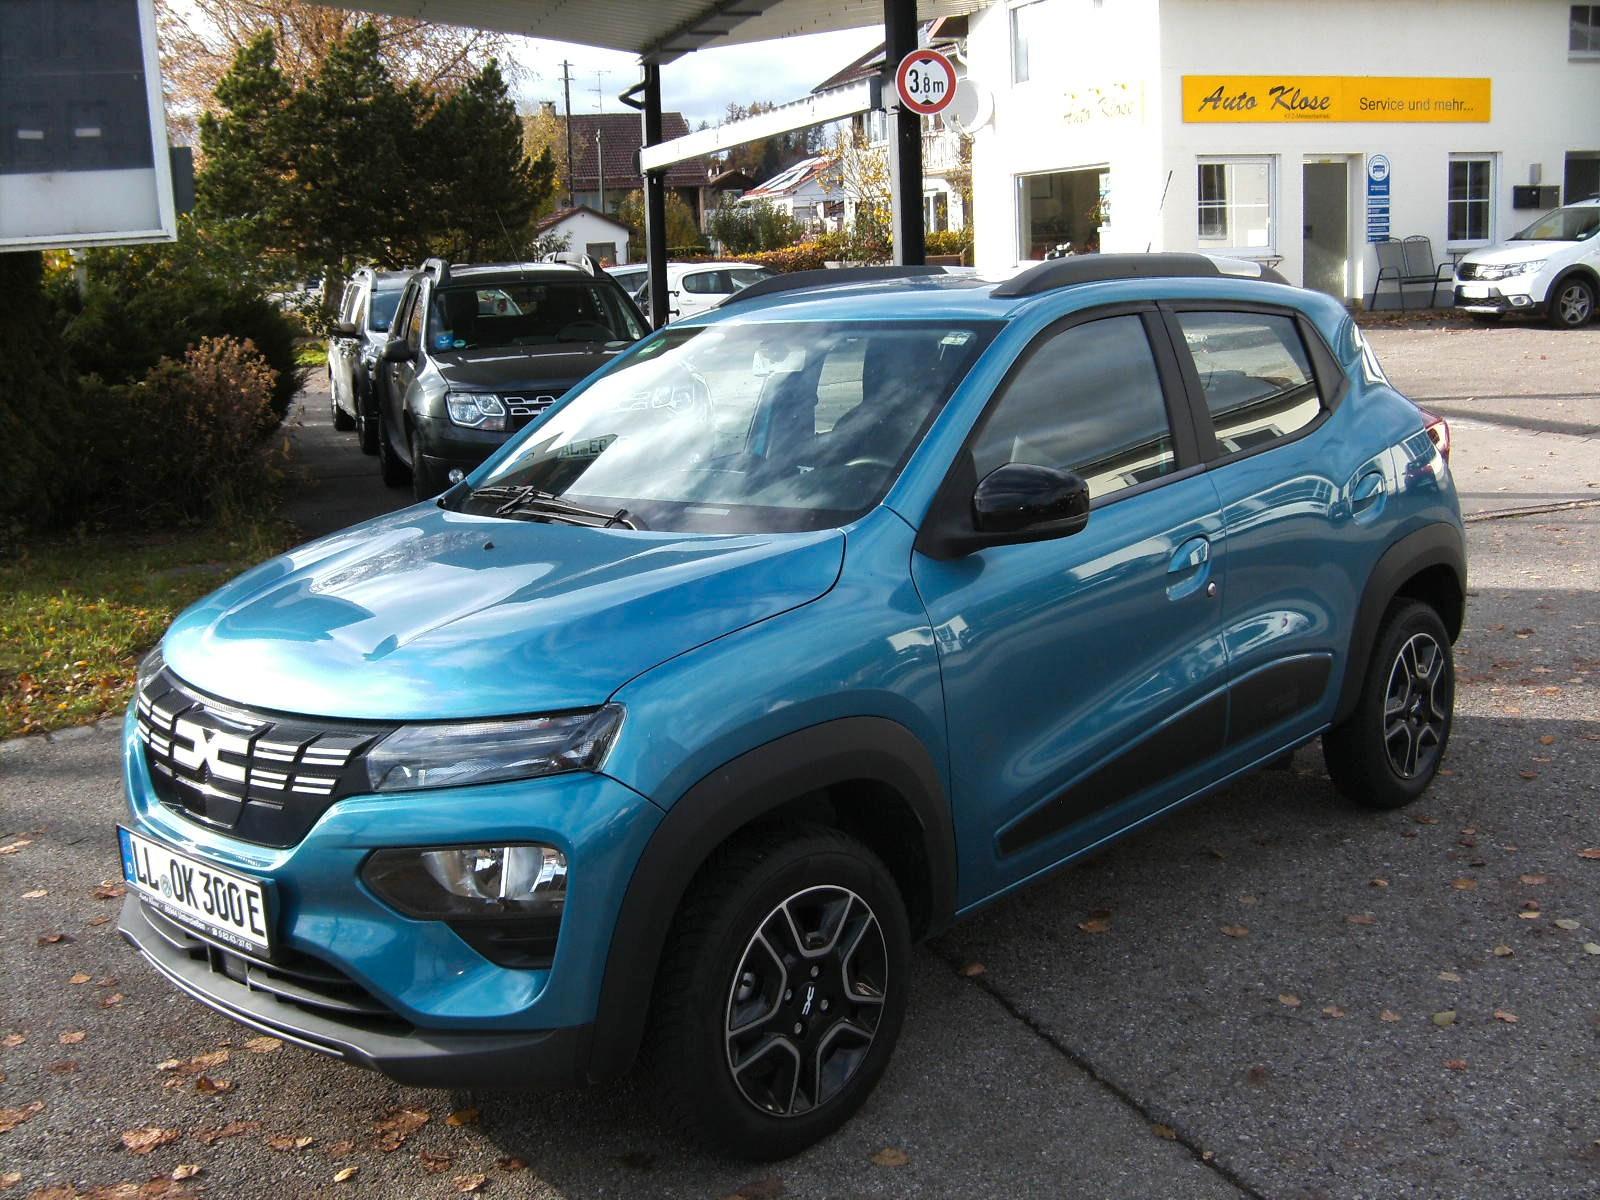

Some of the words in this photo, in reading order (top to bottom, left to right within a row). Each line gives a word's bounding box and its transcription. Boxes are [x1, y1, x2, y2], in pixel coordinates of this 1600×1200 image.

[933, 80, 944, 93] m
[1198, 86, 1257, 112] Auto
[1268, 86, 1330, 111] Klose
[1360, 97, 1404, 111] Service
[1409, 98, 1430, 111] und
[132, 841, 160, 891] LL
[171, 859, 199, 909] OK
